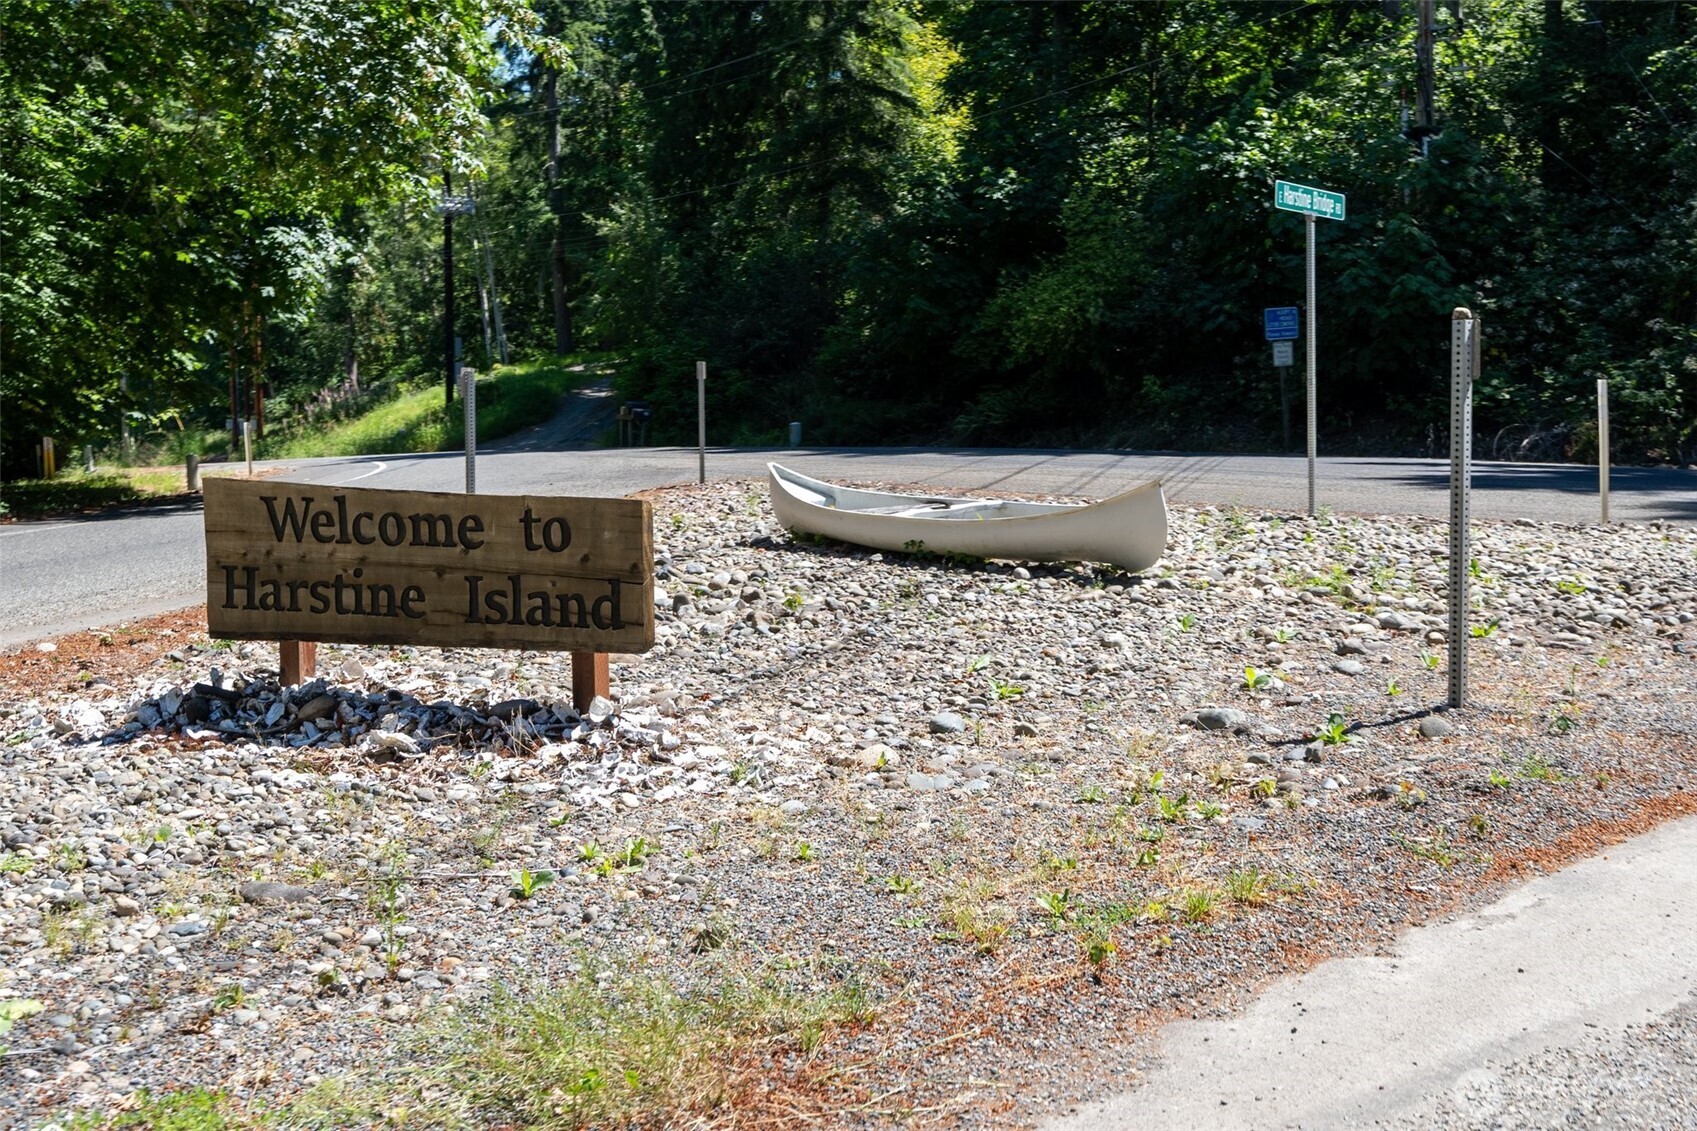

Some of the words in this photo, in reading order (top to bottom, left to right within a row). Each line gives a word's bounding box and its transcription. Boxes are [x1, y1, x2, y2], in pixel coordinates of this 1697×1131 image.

[1312, 191, 1335, 217] Bridge
[259, 494, 485, 550] Welcome
[518, 505, 572, 553] to
[221, 564, 427, 619] Harstine
[464, 575, 627, 631] Island
